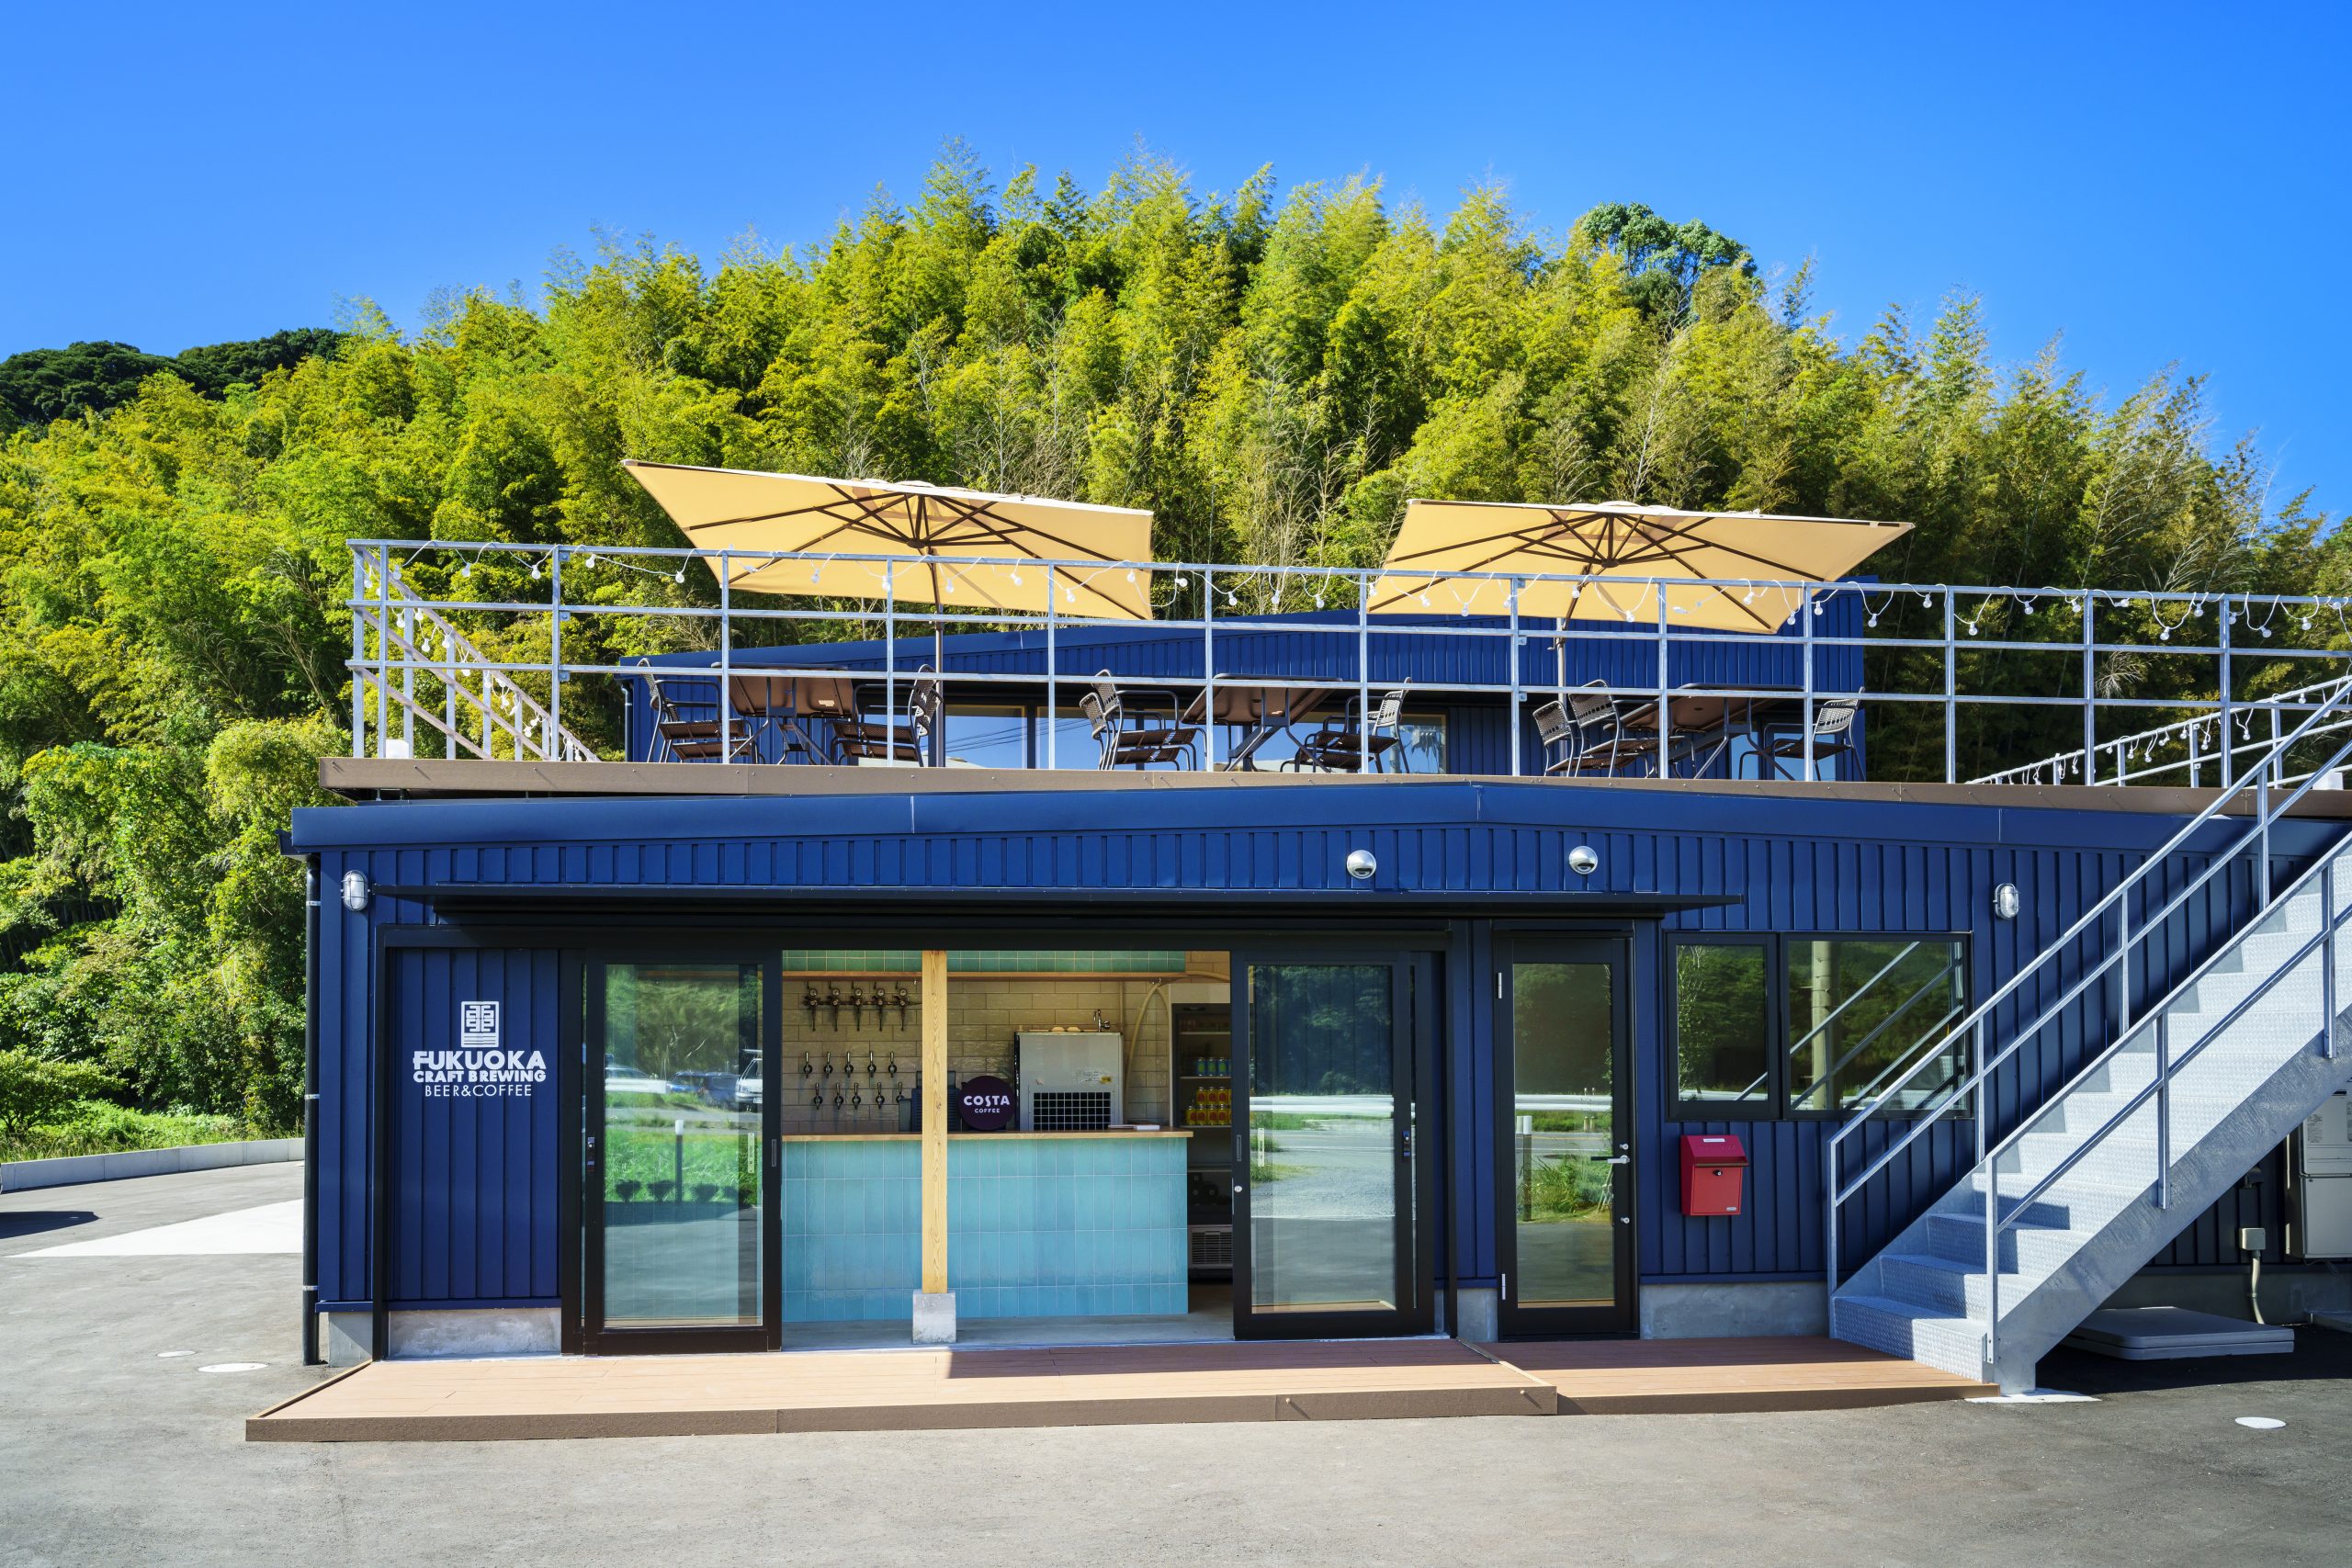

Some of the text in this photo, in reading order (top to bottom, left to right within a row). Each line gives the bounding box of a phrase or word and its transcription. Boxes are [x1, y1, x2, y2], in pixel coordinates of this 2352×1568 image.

[413, 1051, 547, 1070] FUKUOKA
[413, 1070, 547, 1083] CRAFT BREWING
[424, 1084, 532, 1097] BEER&COFFEE
[963, 1095, 1011, 1106] COSTA
